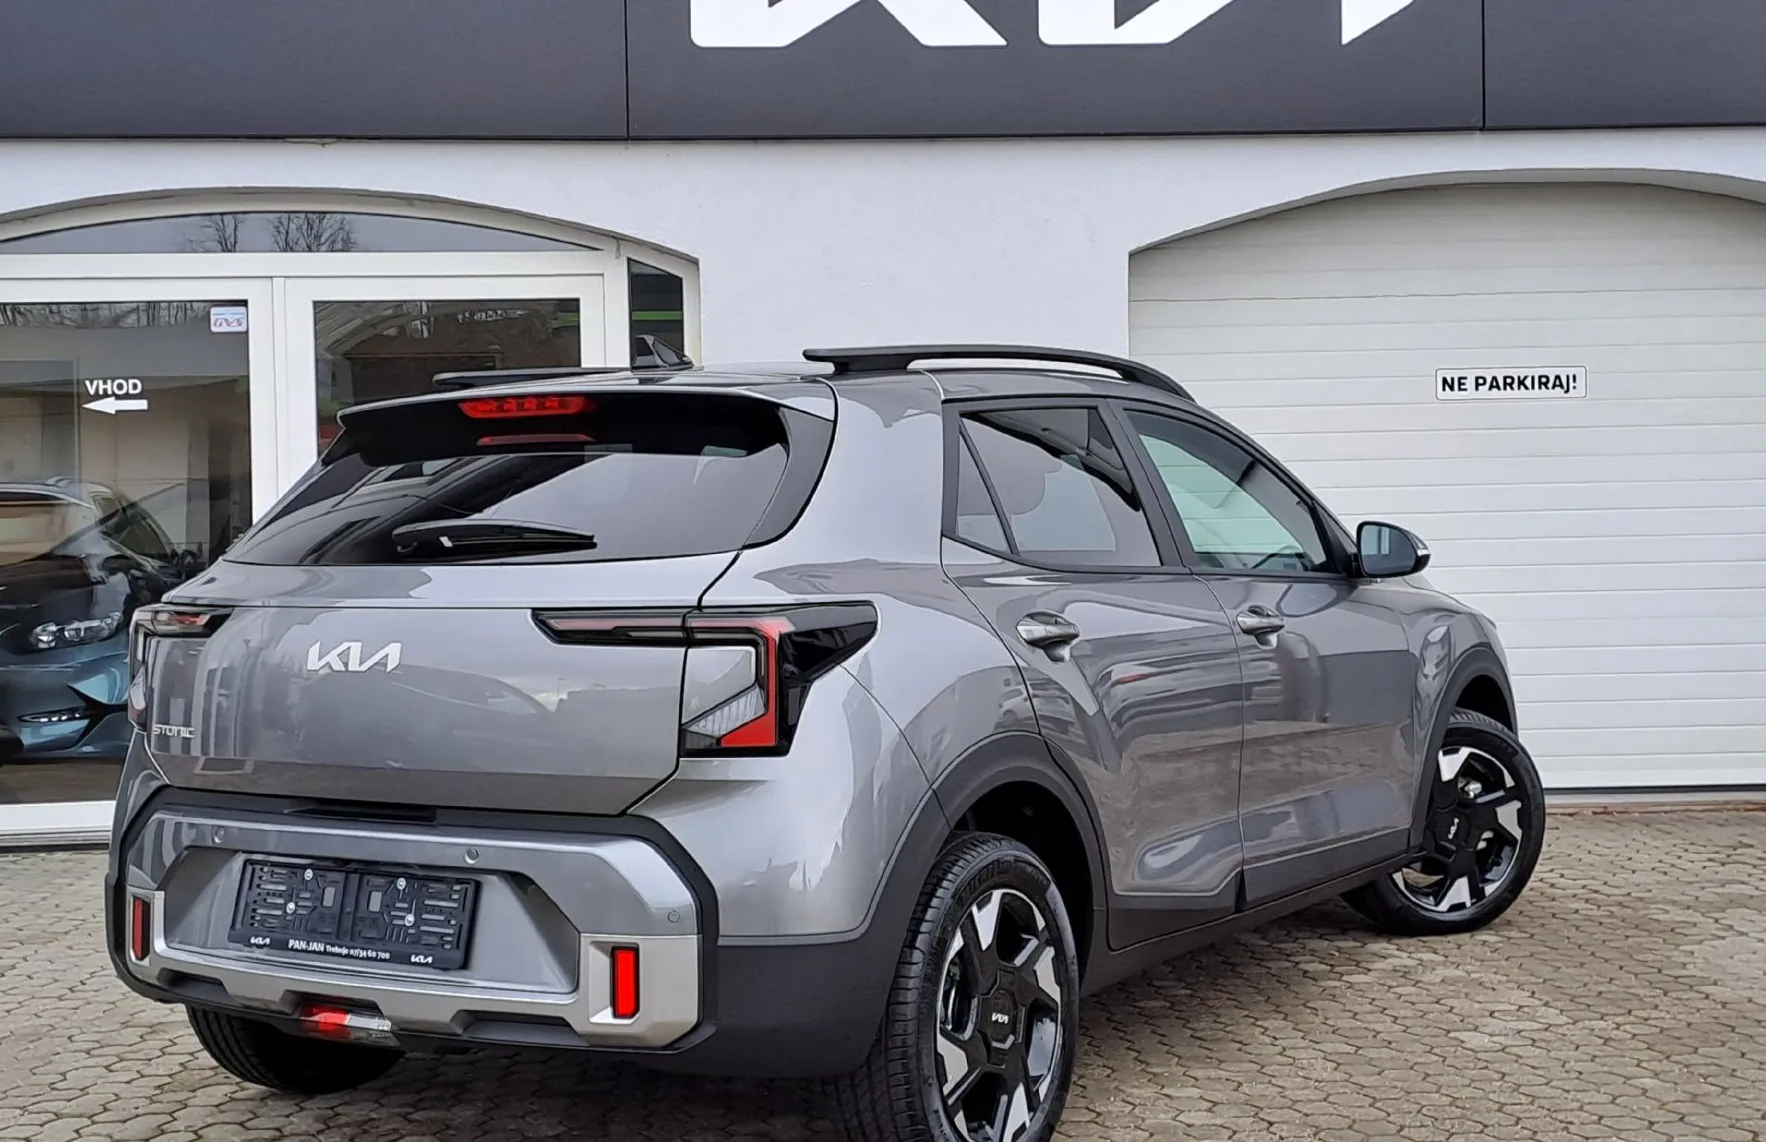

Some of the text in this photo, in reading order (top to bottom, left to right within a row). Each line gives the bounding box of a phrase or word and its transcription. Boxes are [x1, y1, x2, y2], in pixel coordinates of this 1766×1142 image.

[85, 379, 142, 395] VHOD
[1441, 374, 1577, 394] NE PARKIRAJ!
[306, 641, 402, 673] KIA
[250, 936, 270, 945] KIA
[288, 939, 324, 952] PAN-JAN
[411, 954, 433, 964] KIA
